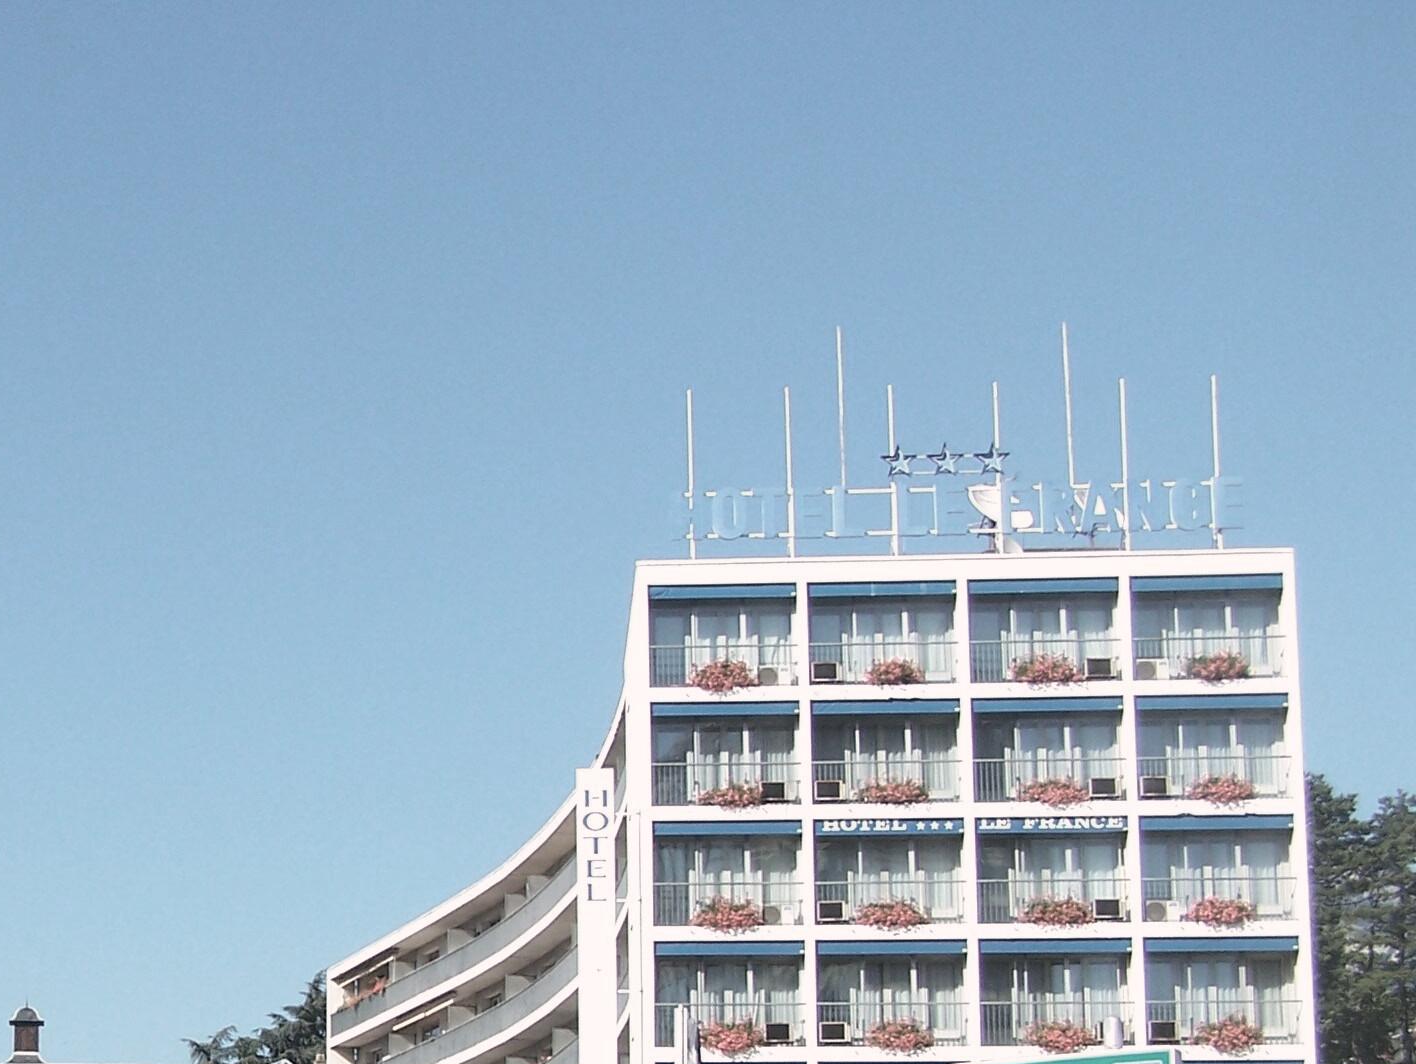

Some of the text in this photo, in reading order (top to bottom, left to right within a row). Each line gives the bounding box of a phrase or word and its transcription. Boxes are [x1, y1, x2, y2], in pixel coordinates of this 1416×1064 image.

[583, 790, 608, 901] HOTEL
[822, 818, 1123, 832] HOTEL LE FRANCE
